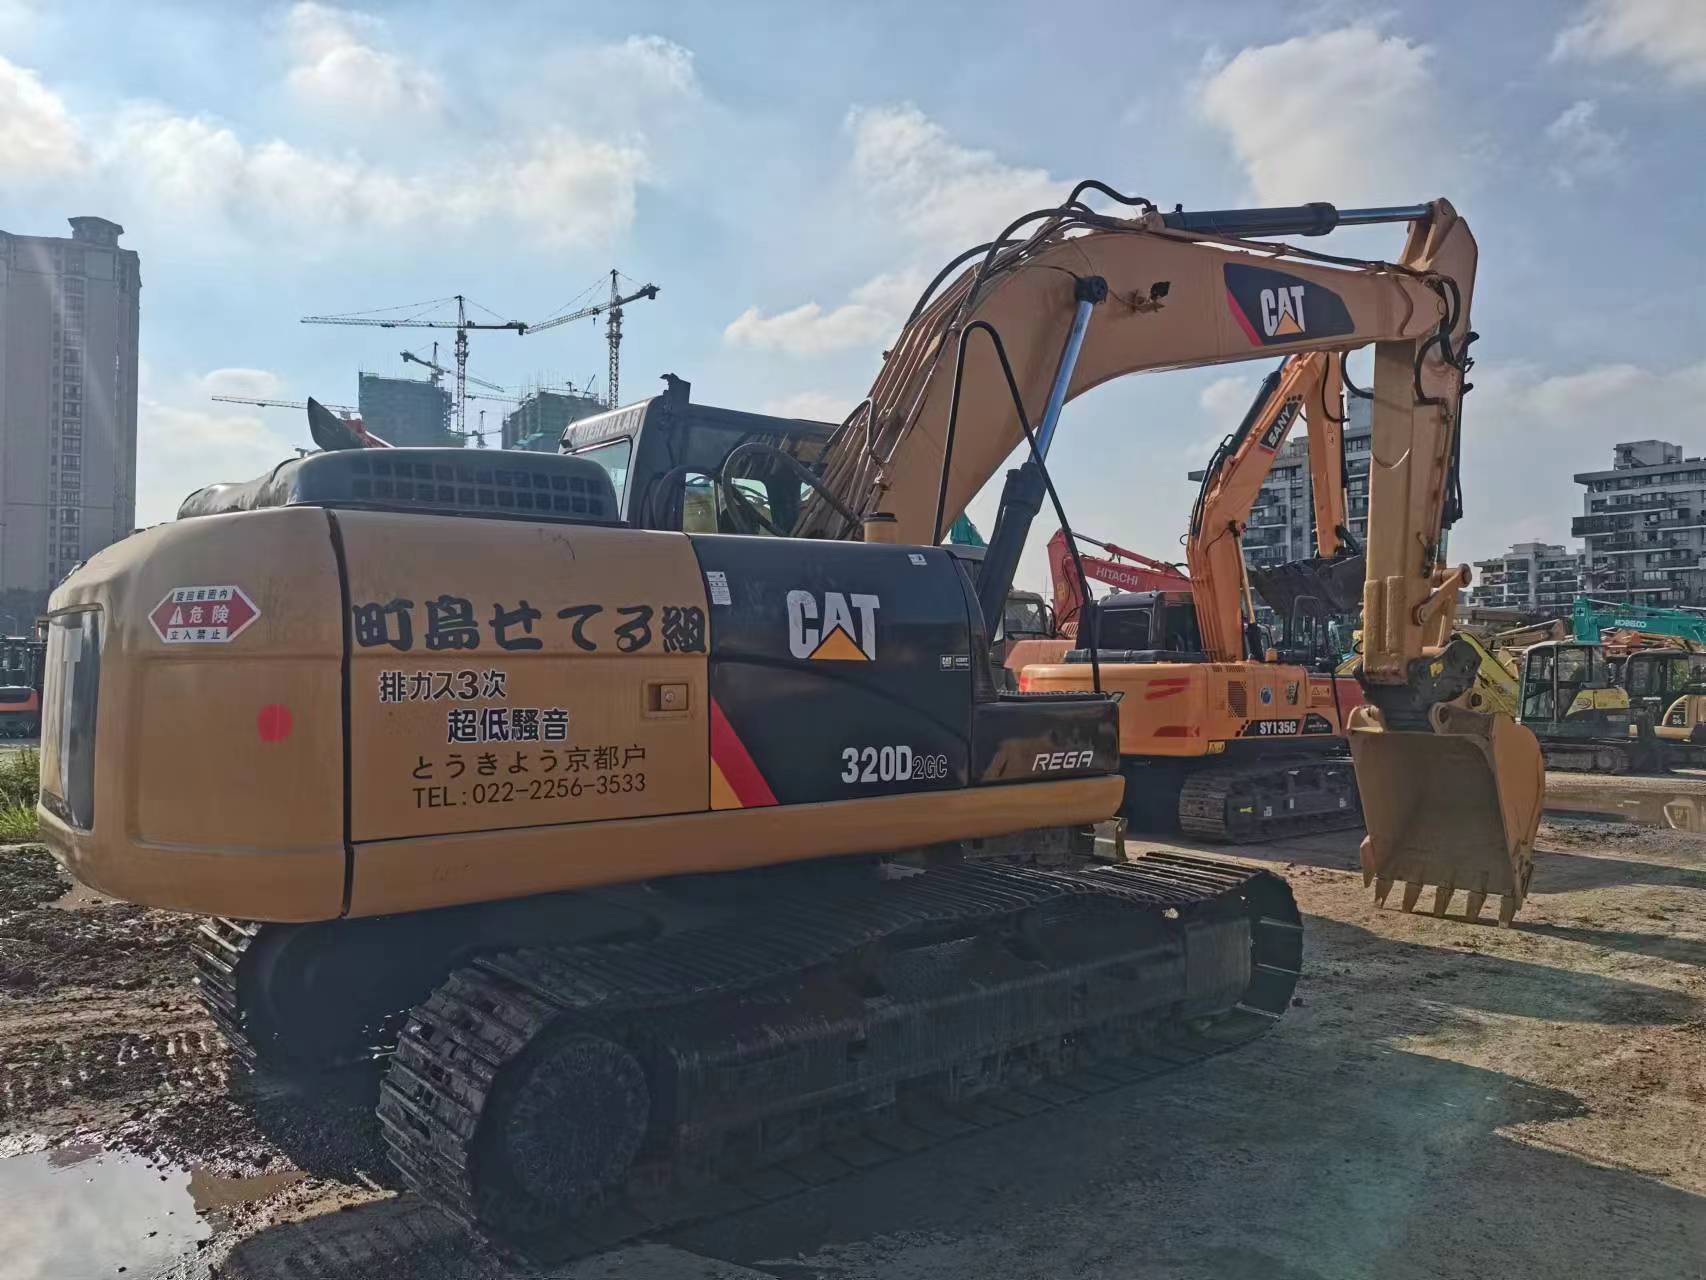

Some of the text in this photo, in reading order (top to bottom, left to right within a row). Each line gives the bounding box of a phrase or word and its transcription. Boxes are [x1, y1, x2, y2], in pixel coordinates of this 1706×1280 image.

[1260, 285, 1305, 337] CAT
[1268, 405, 1290, 447] SANY
[1096, 567, 1139, 586] HITACHI
[189, 605, 230, 624] 危険
[786, 589, 881, 662] CAT
[170, 629, 221, 640] 立入禁止
[378, 669, 507, 704] 排ガス3次
[447, 708, 569, 744] 超低騒音
[1259, 720, 1297, 735] SY135C
[1032, 750, 1094, 773] REGA
